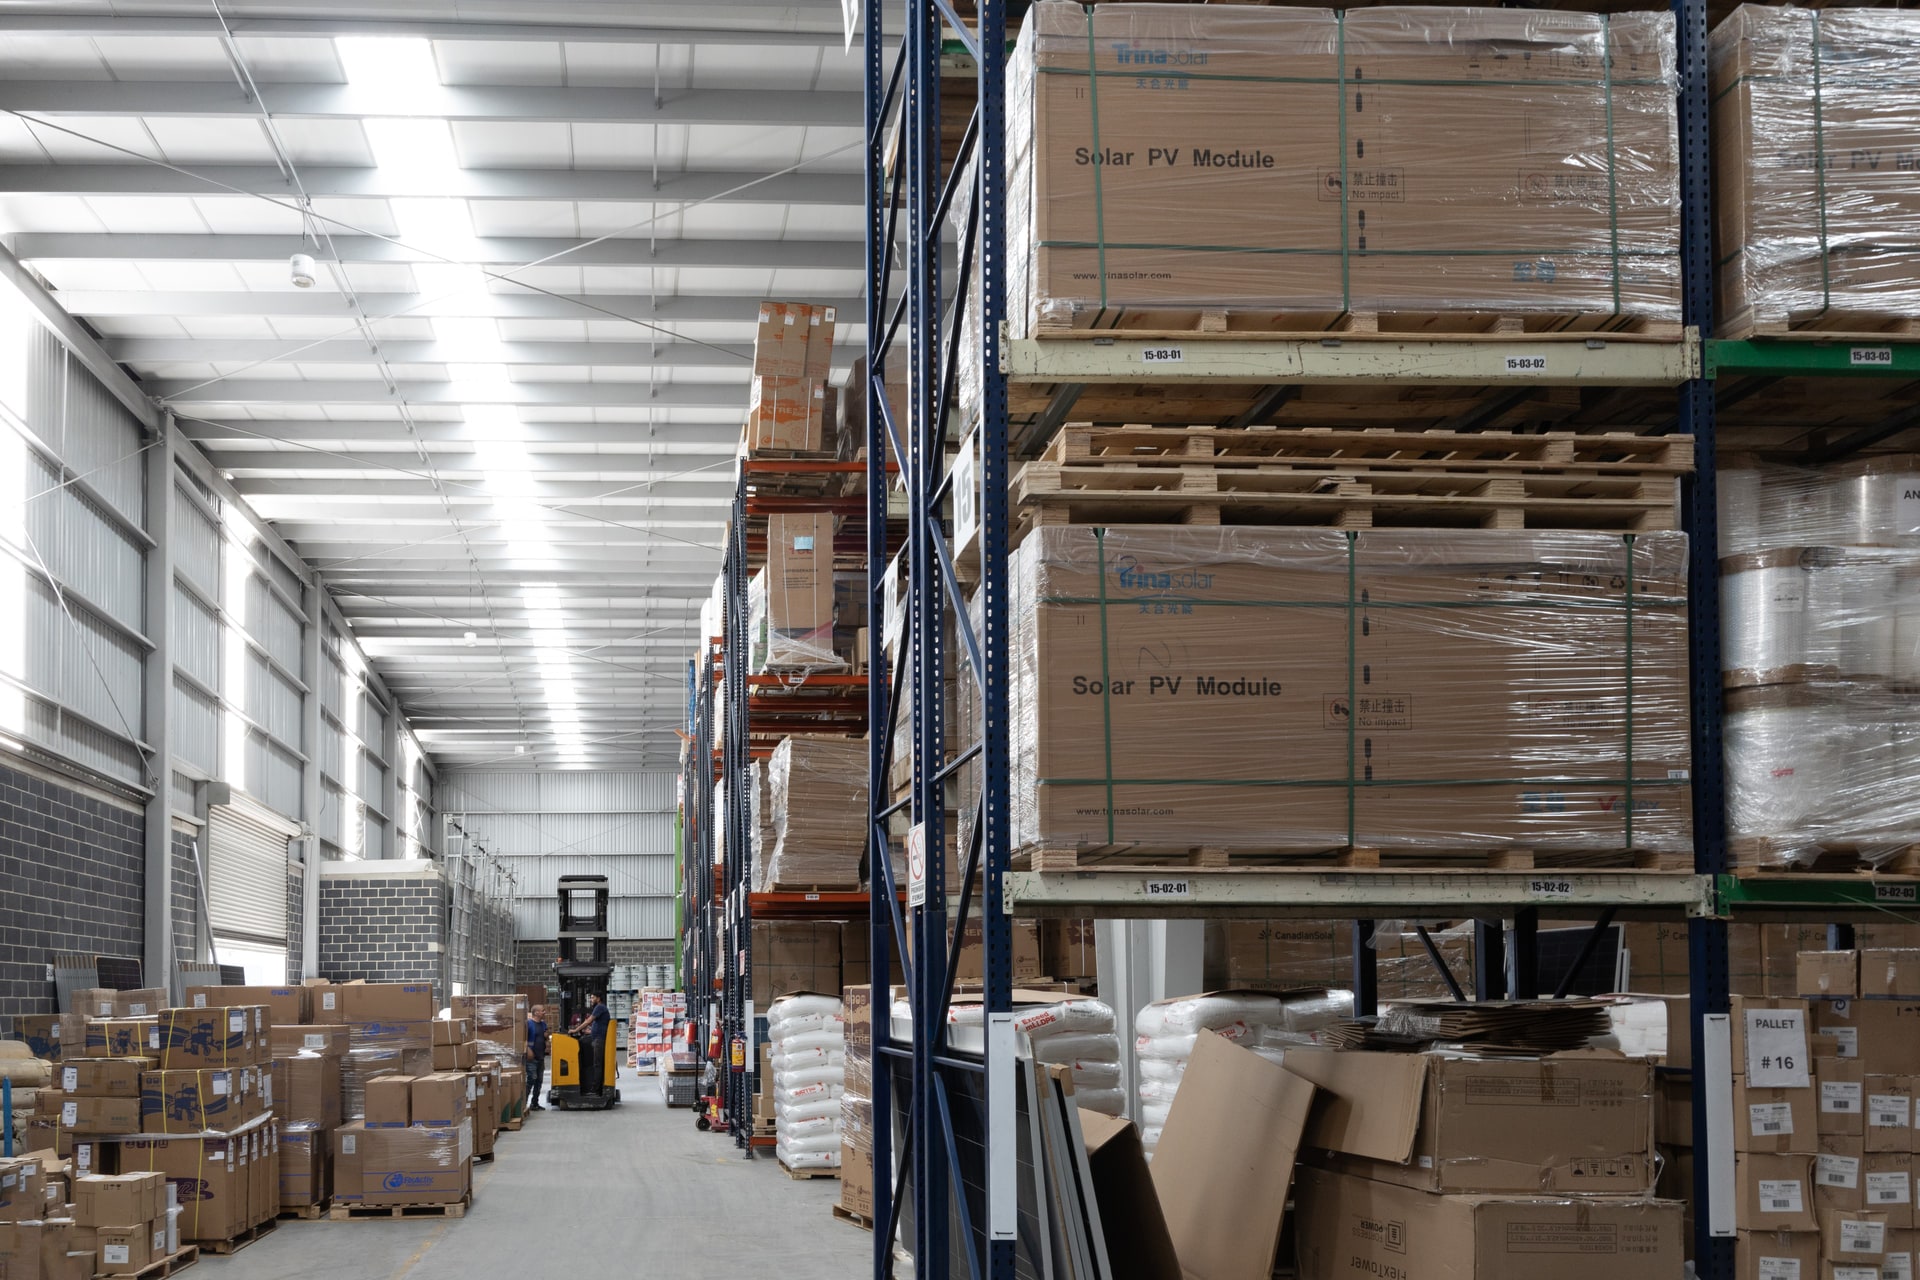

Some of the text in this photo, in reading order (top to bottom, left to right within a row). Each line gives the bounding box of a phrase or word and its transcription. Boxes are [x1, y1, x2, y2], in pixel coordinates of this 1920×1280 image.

[1148, 148, 1179, 166] PV
[1193, 148, 1275, 168] Module
[1851, 150, 1881, 170] PV
[1352, 190, 1400, 201] No impact
[1143, 350, 1182, 361] 15-03-01
[1852, 351, 1890, 362] 15-03-03
[1506, 358, 1545, 369] 15-03-02
[955, 462, 972, 533] 15
[884, 576, 897, 629] 16
[1150, 676, 1182, 695] PV
[1196, 676, 1283, 696] Module
[1359, 717, 1406, 728] No impact
[1149, 883, 1187, 893] 15-02-01
[1531, 881, 1570, 893] 15-02-02
[1877, 886, 1915, 898] 15-02-03
[1755, 1018, 1796, 1030] PALLET
[1761, 1056, 1795, 1070] # 16
